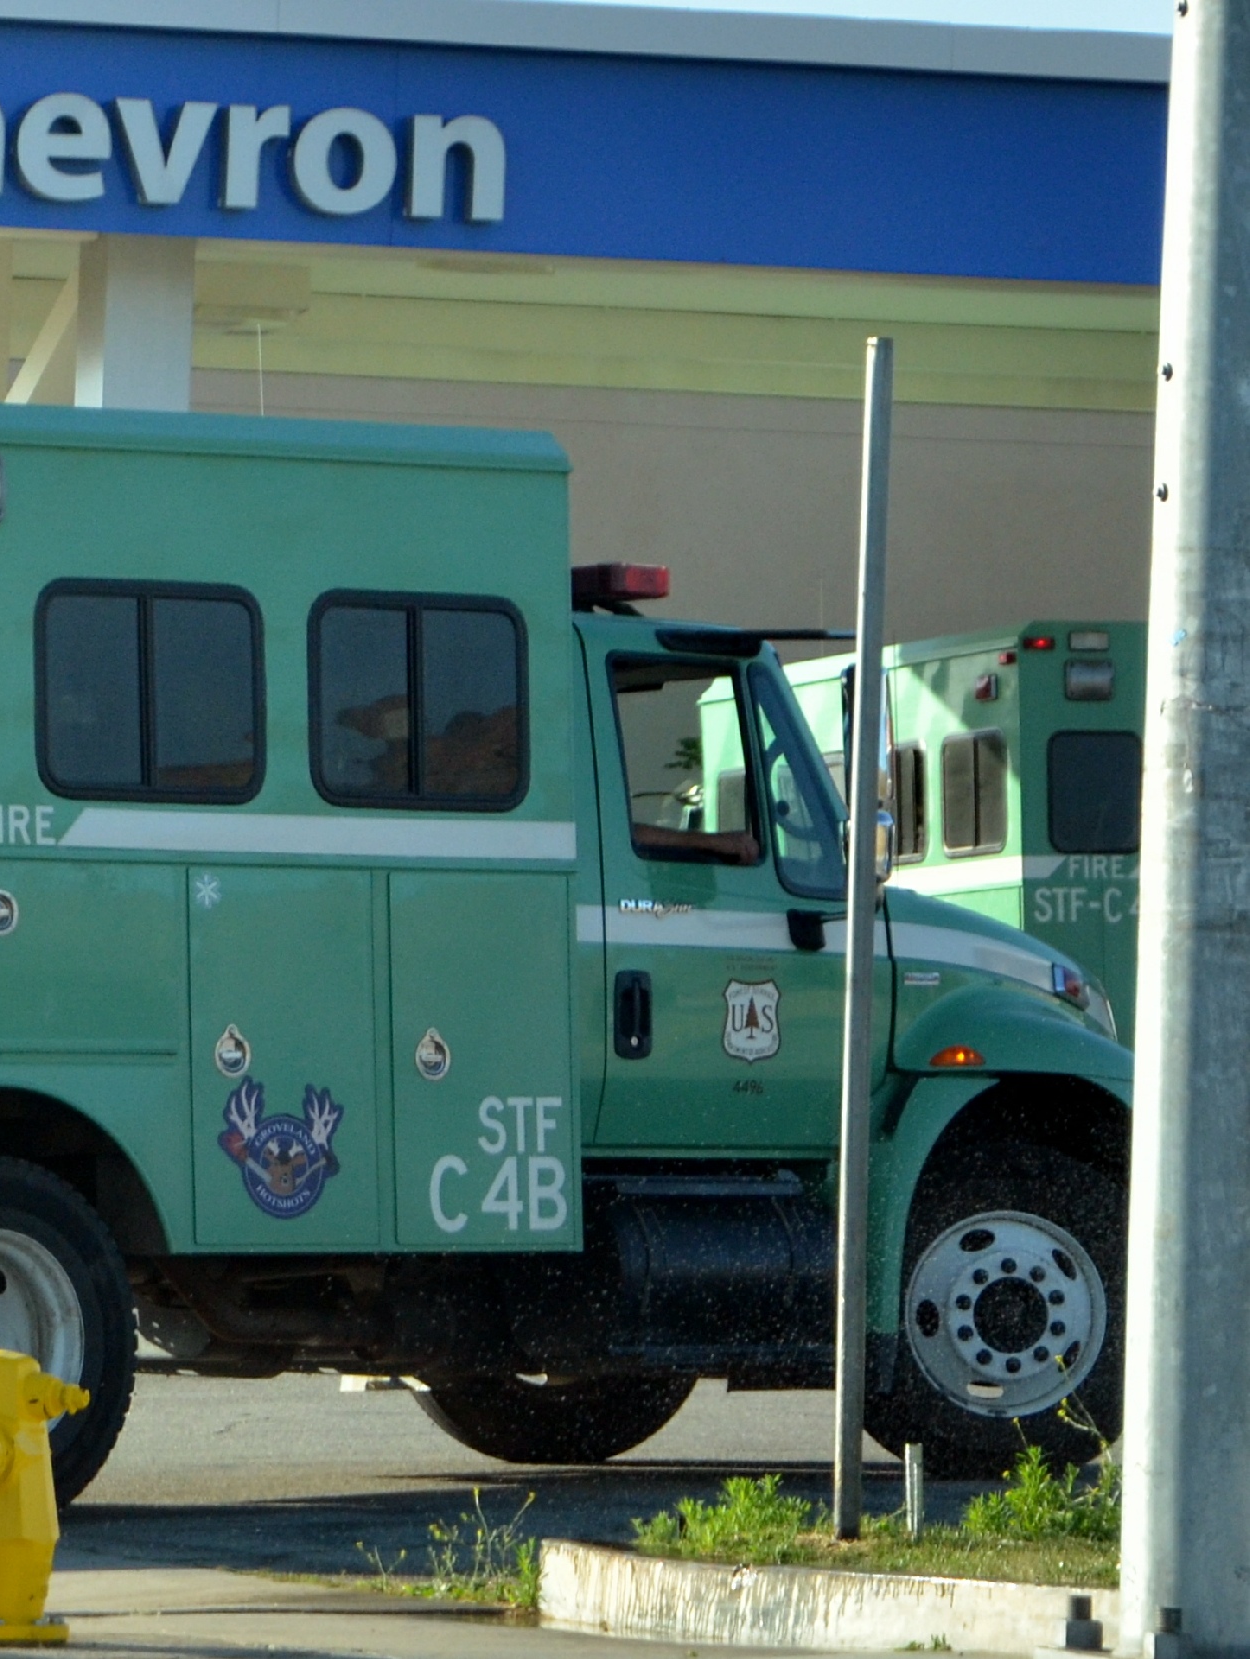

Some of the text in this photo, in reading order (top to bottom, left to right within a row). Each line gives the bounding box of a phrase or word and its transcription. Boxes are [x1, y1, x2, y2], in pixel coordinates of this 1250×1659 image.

[1069, 854, 1125, 878] FIRE
[732, 1004, 773, 1033] U S
[254, 1123, 316, 1155] GROVELAND
[478, 1096, 562, 1154] STF
[256, 1184, 311, 1208] HOTSHOTS
[430, 1155, 468, 1233] C
